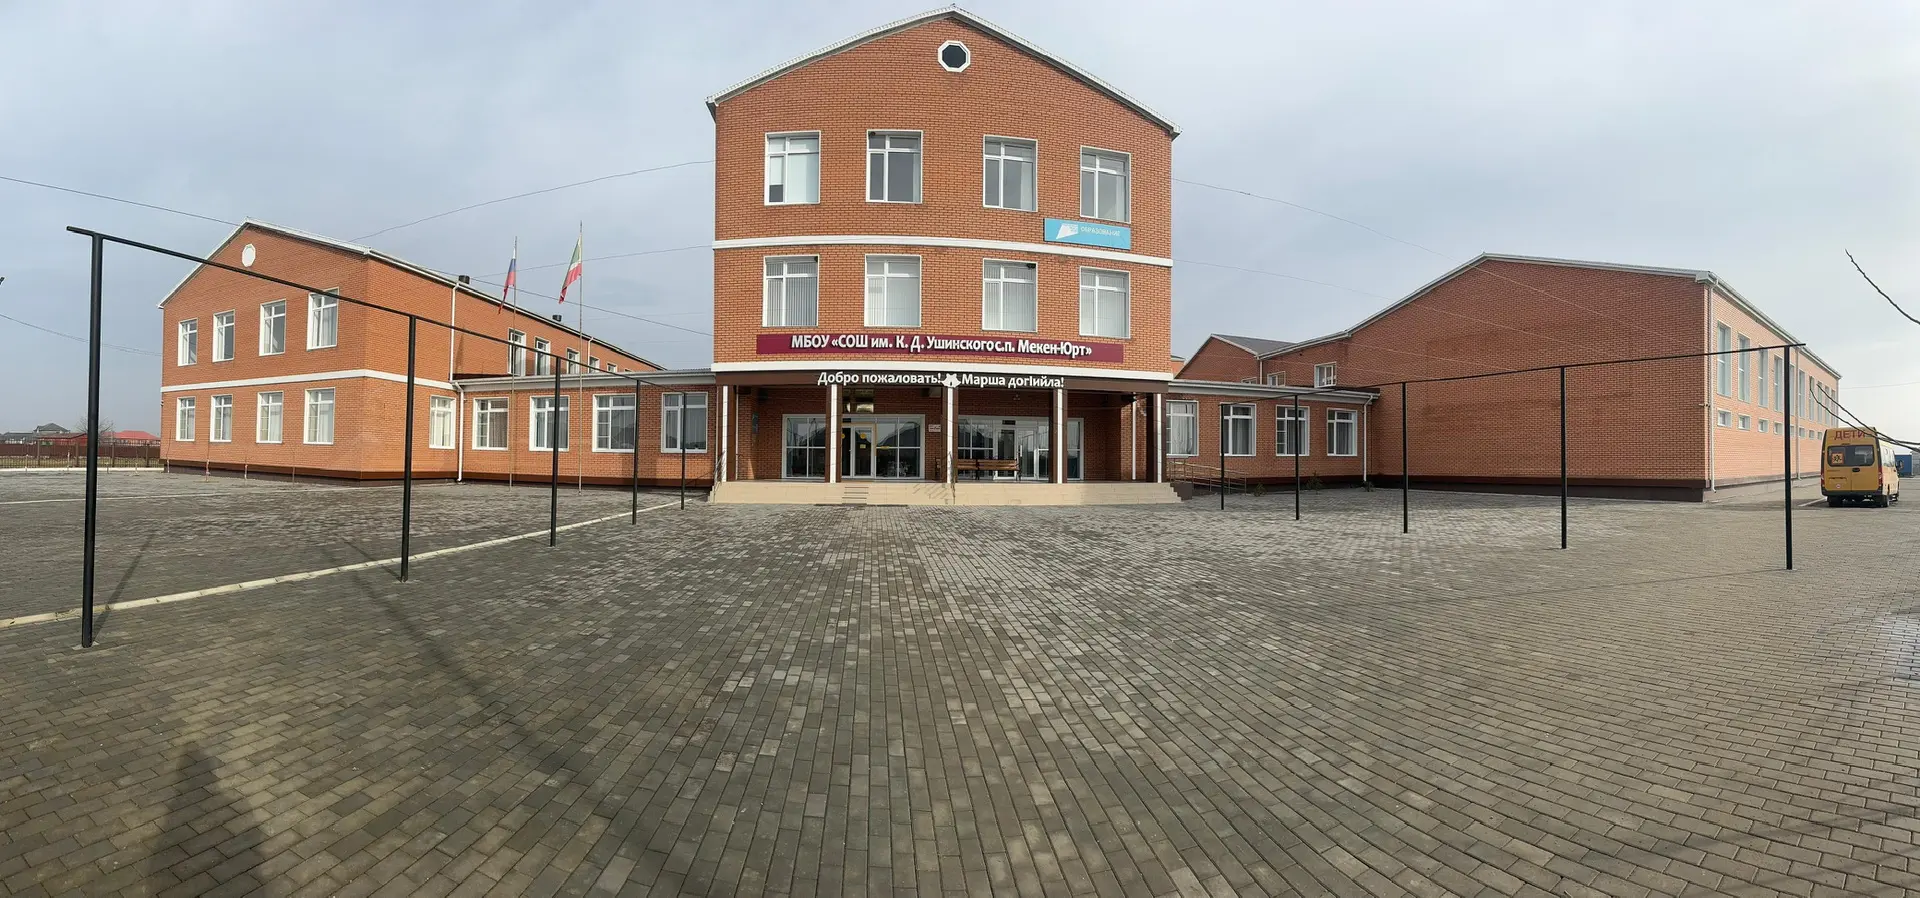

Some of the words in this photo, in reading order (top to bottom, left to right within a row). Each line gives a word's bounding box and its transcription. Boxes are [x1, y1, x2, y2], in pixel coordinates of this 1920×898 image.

[791, 335, 830, 348] МБОУ
[831, 335, 868, 348] «СОШ
[871, 337, 893, 348] им.
[896, 335, 909, 349] К.
[910, 336, 925, 352] Д.
[1018, 339, 1092, 358] Мекен-Юрт»
[818, 371, 860, 386] Добро
[862, 372, 941, 385] пожаловать!
[962, 373, 1006, 388] Марша
[1834, 430, 1865, 440] ДЕТИ
